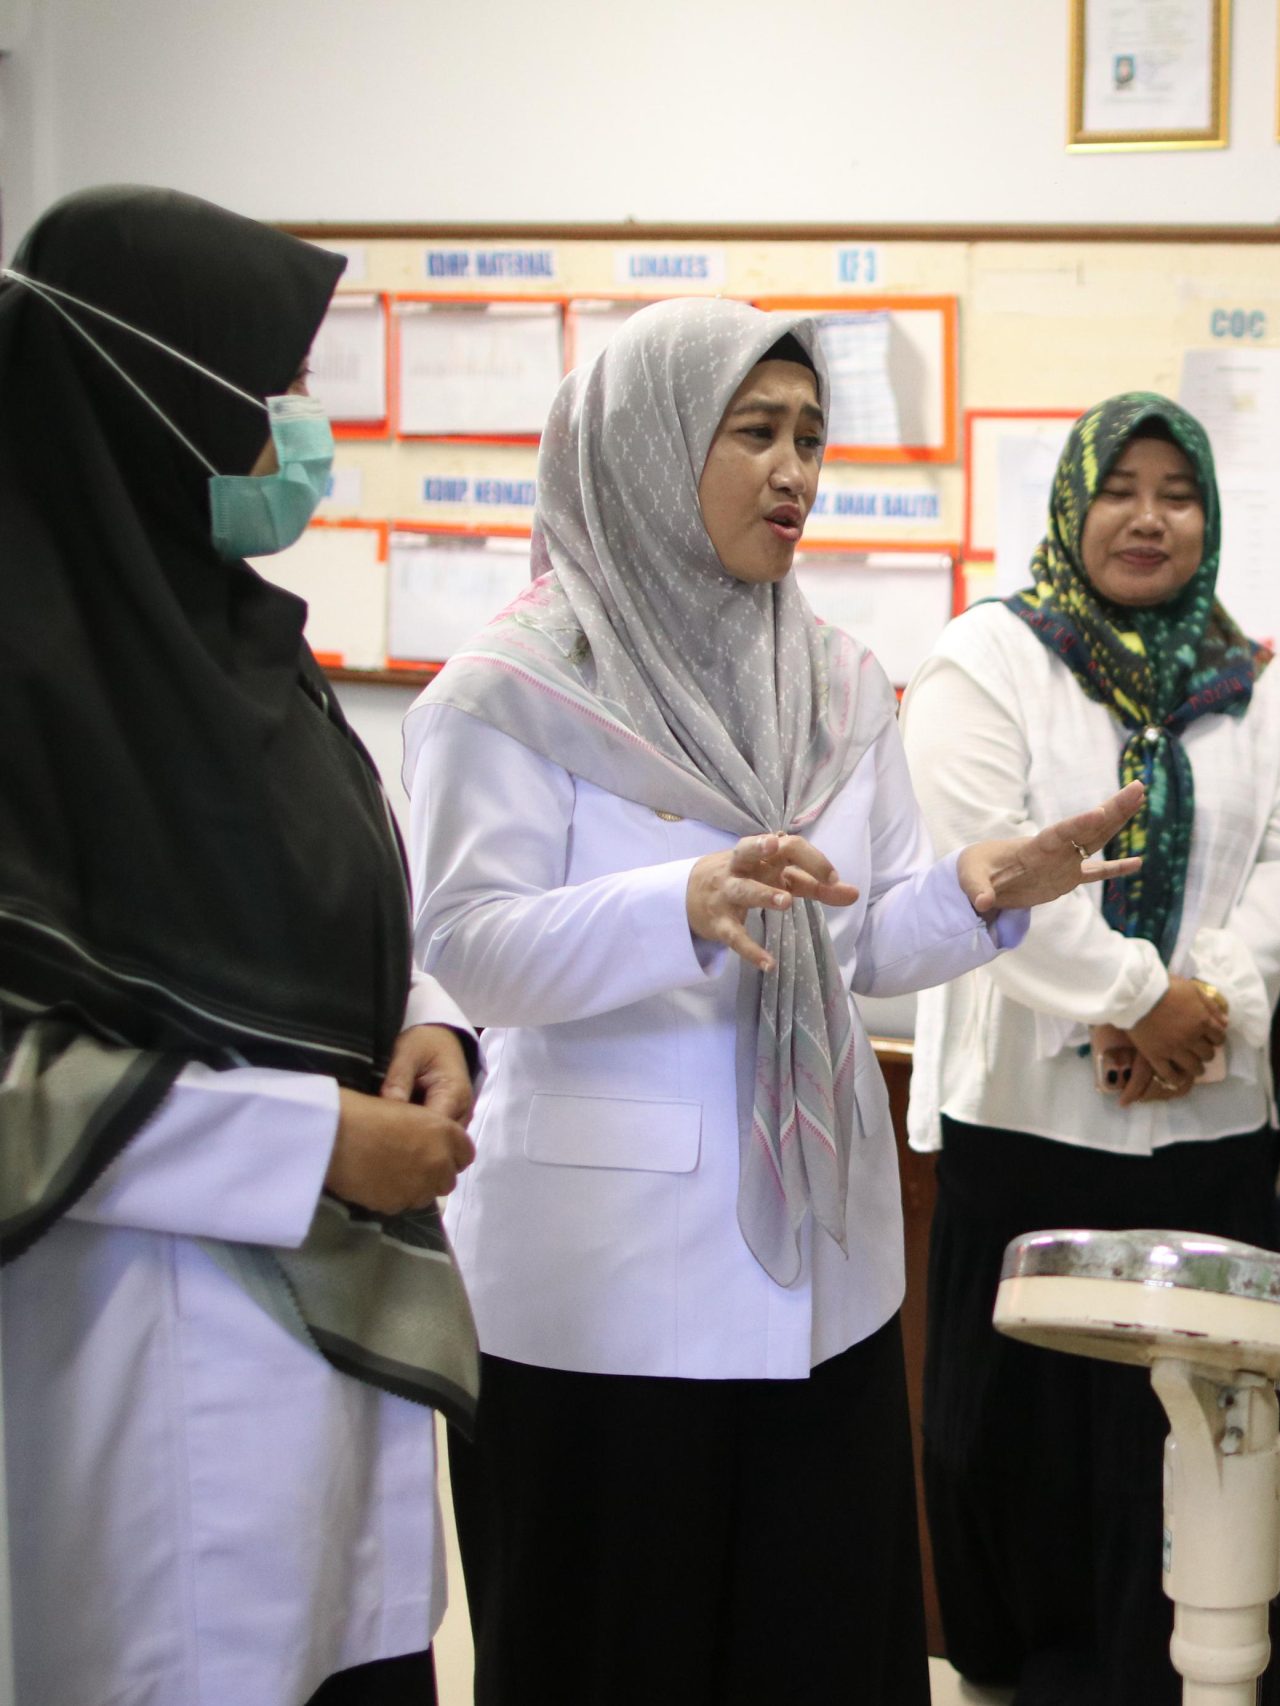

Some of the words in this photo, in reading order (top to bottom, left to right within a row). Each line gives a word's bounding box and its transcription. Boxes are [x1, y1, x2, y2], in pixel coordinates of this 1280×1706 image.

[476, 250, 554, 277] MATERNAL
[838, 248, 860, 283] KF
[864, 249, 876, 283] 3
[1210, 307, 1265, 338] COC
[835, 491, 876, 516] ANAK
